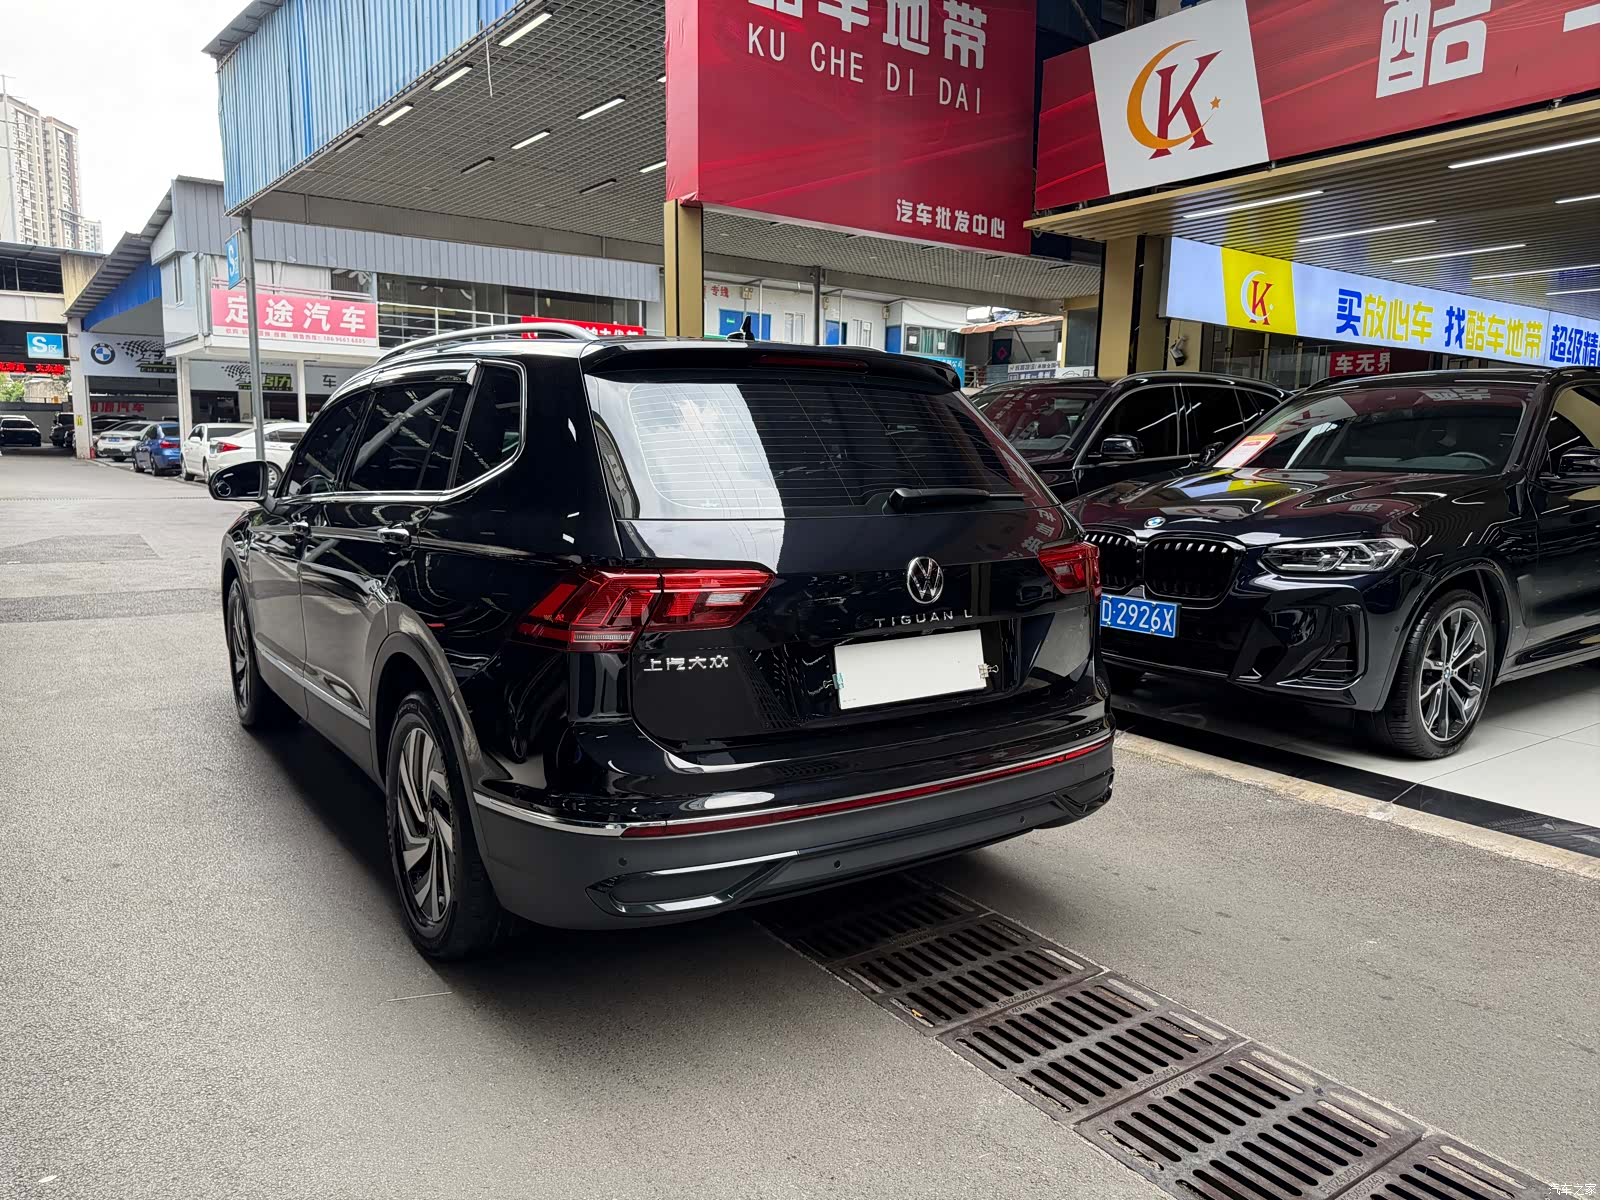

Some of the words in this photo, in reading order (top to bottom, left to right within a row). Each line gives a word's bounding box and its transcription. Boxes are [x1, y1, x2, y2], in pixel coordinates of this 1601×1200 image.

[749, 0, 987, 69] 地带
[748, 23, 785, 61] KU
[810, 41, 864, 83] CHE
[887, 62, 914, 96] DI
[939, 77, 981, 114] DAI
[897, 198, 1006, 240] 汽车批发中心
[225, 295, 366, 333] 定途汽车
[1336, 288, 1433, 344] 买放心车
[1445, 305, 1544, 359] 找酷车地带
[1549, 324, 1601, 366] 超级精
[238, 373, 292, 389] 车引力
[322, 374, 336, 388] 车
[874, 610, 954, 628] TIGUAN
[964, 609, 973, 618] L
[643, 654, 729, 672] 上汽大众
